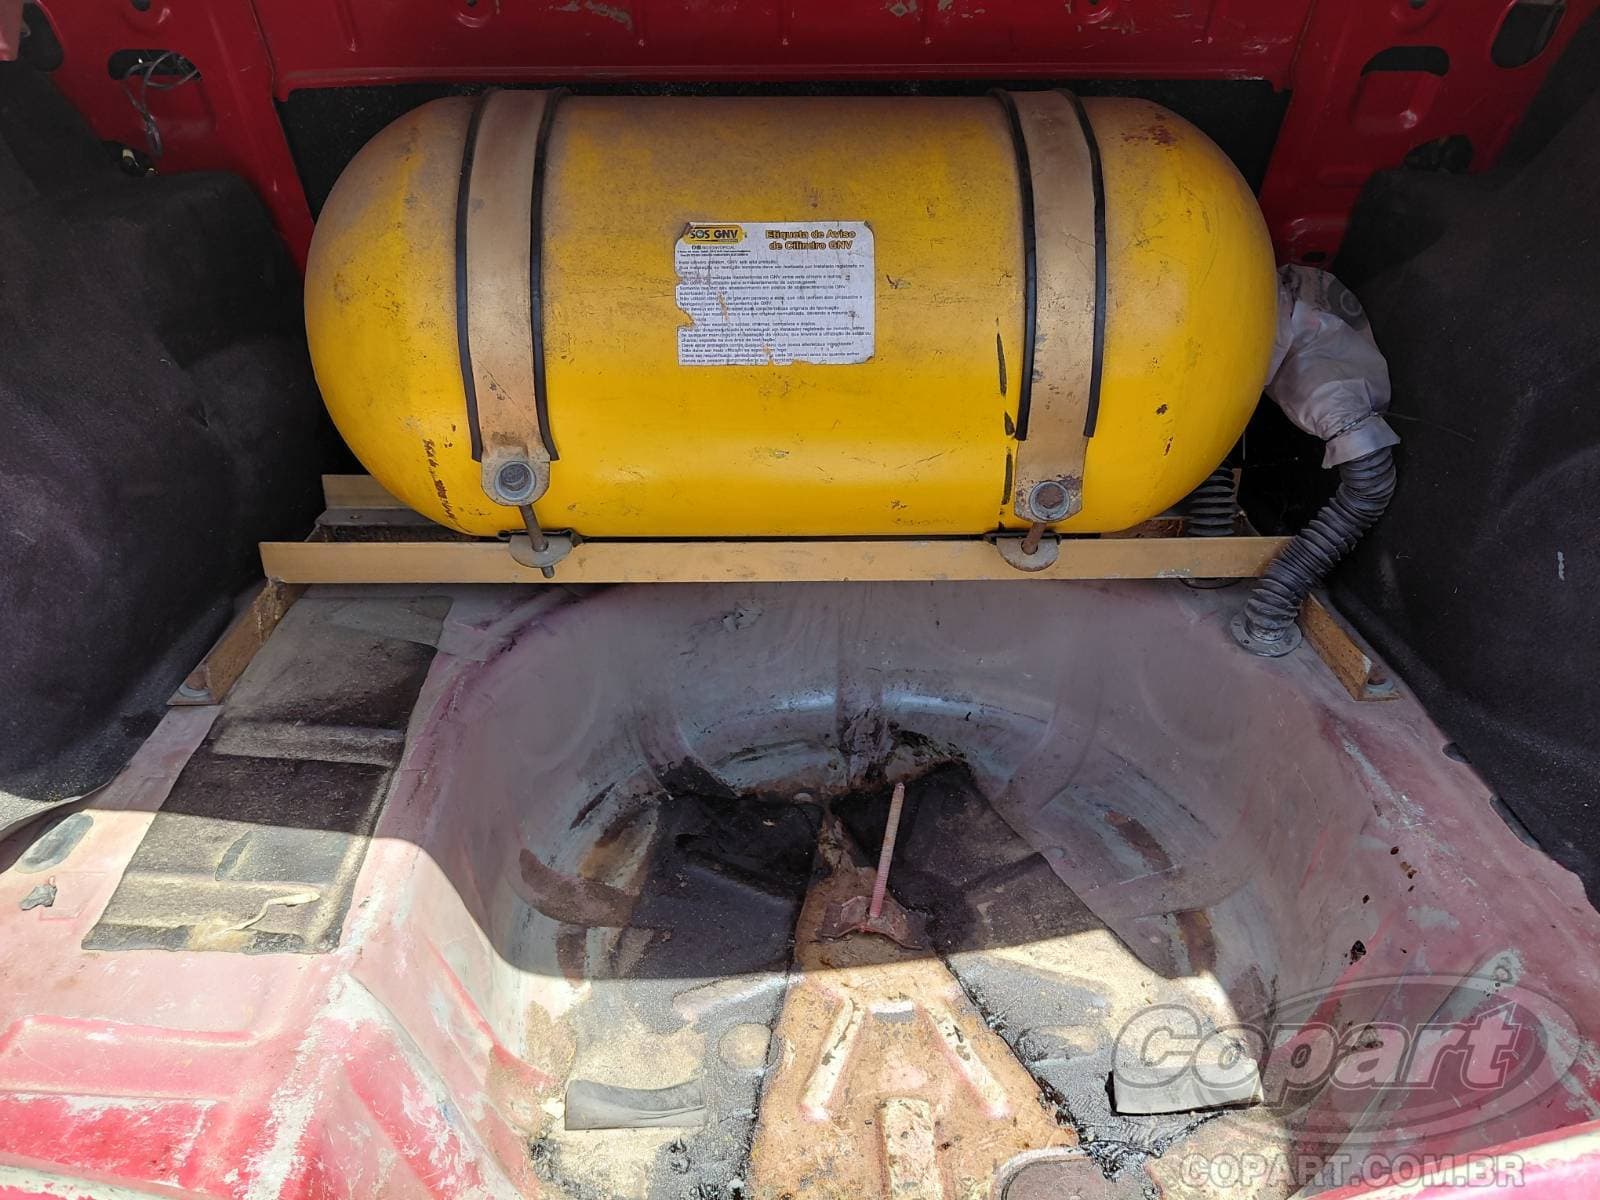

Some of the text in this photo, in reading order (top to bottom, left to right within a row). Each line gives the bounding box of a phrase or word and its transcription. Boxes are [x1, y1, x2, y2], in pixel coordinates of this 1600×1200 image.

[690, 230, 738, 239] SOS GNV
[766, 229, 856, 241] Etiqueta de Aviso
[769, 240, 853, 250] de Cilindro GNV
